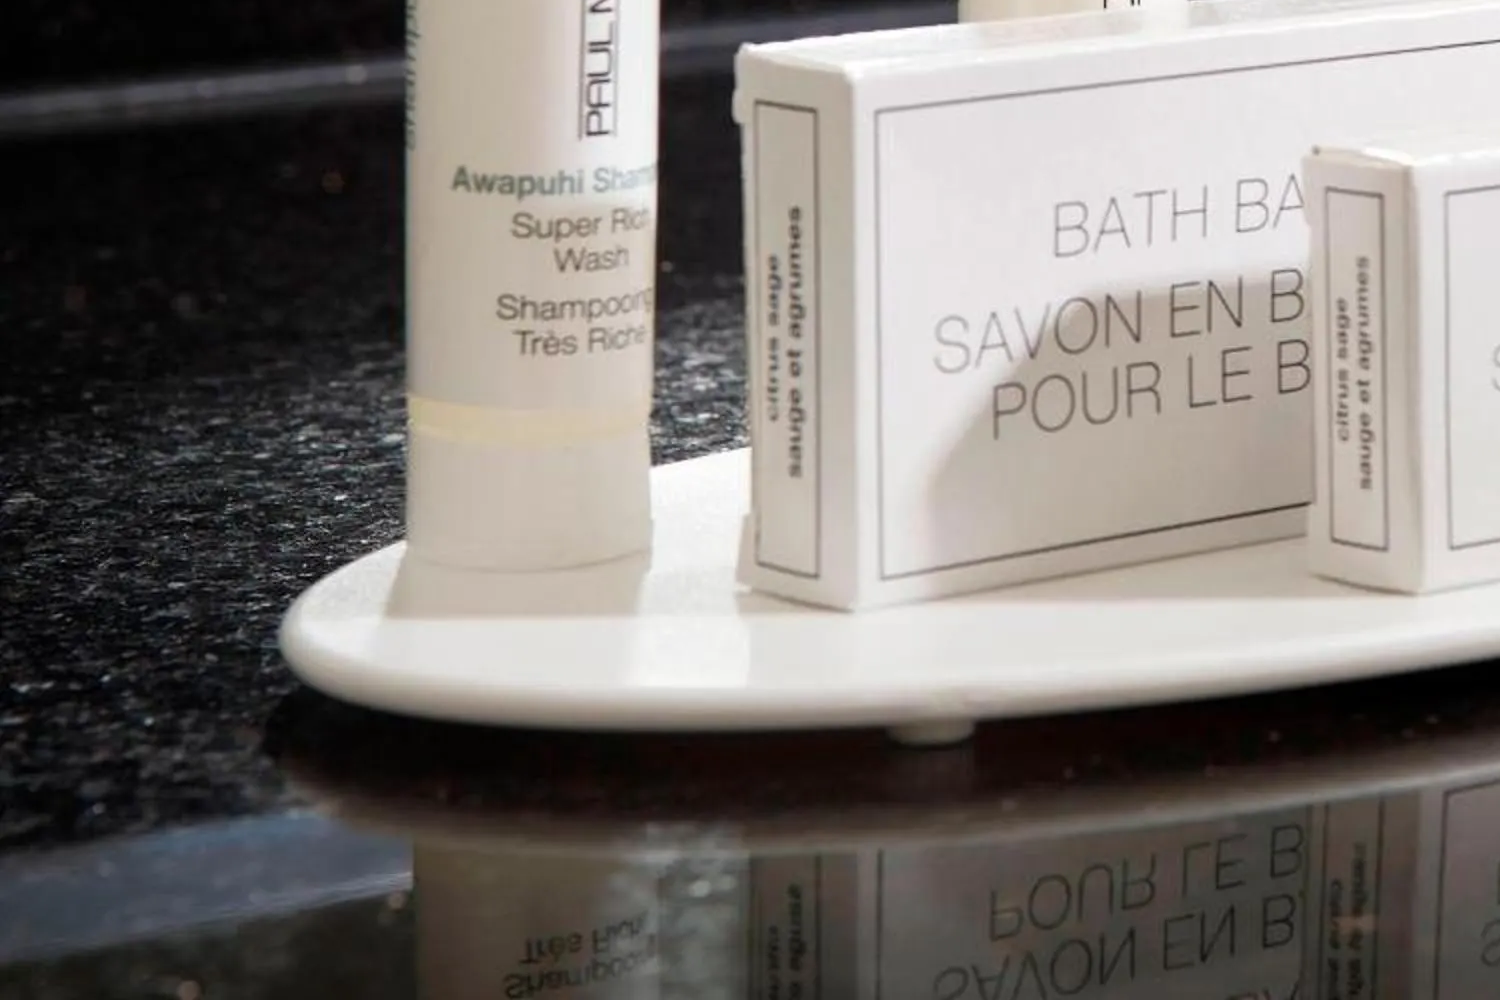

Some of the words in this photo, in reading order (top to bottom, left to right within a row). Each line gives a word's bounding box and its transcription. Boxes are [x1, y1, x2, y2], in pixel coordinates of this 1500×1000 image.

[586, 22, 616, 138] PAUL
[451, 164, 585, 202] Awapuhi
[510, 211, 602, 243] Super
[1053, 185, 1209, 258] BATH
[553, 245, 630, 274] Wash
[512, 329, 579, 357] Très
[931, 289, 1143, 375] SAVON
[1169, 275, 1244, 339] EN
[1335, 297, 1352, 360] sage
[1355, 255, 1375, 371] agrumes
[786, 348, 802, 378] et
[992, 360, 1163, 441] POUR
[1187, 345, 1253, 409] LE
[1355, 378, 1372, 405] et
[1335, 367, 1350, 443] citrus
[1358, 411, 1376, 491] sauge
